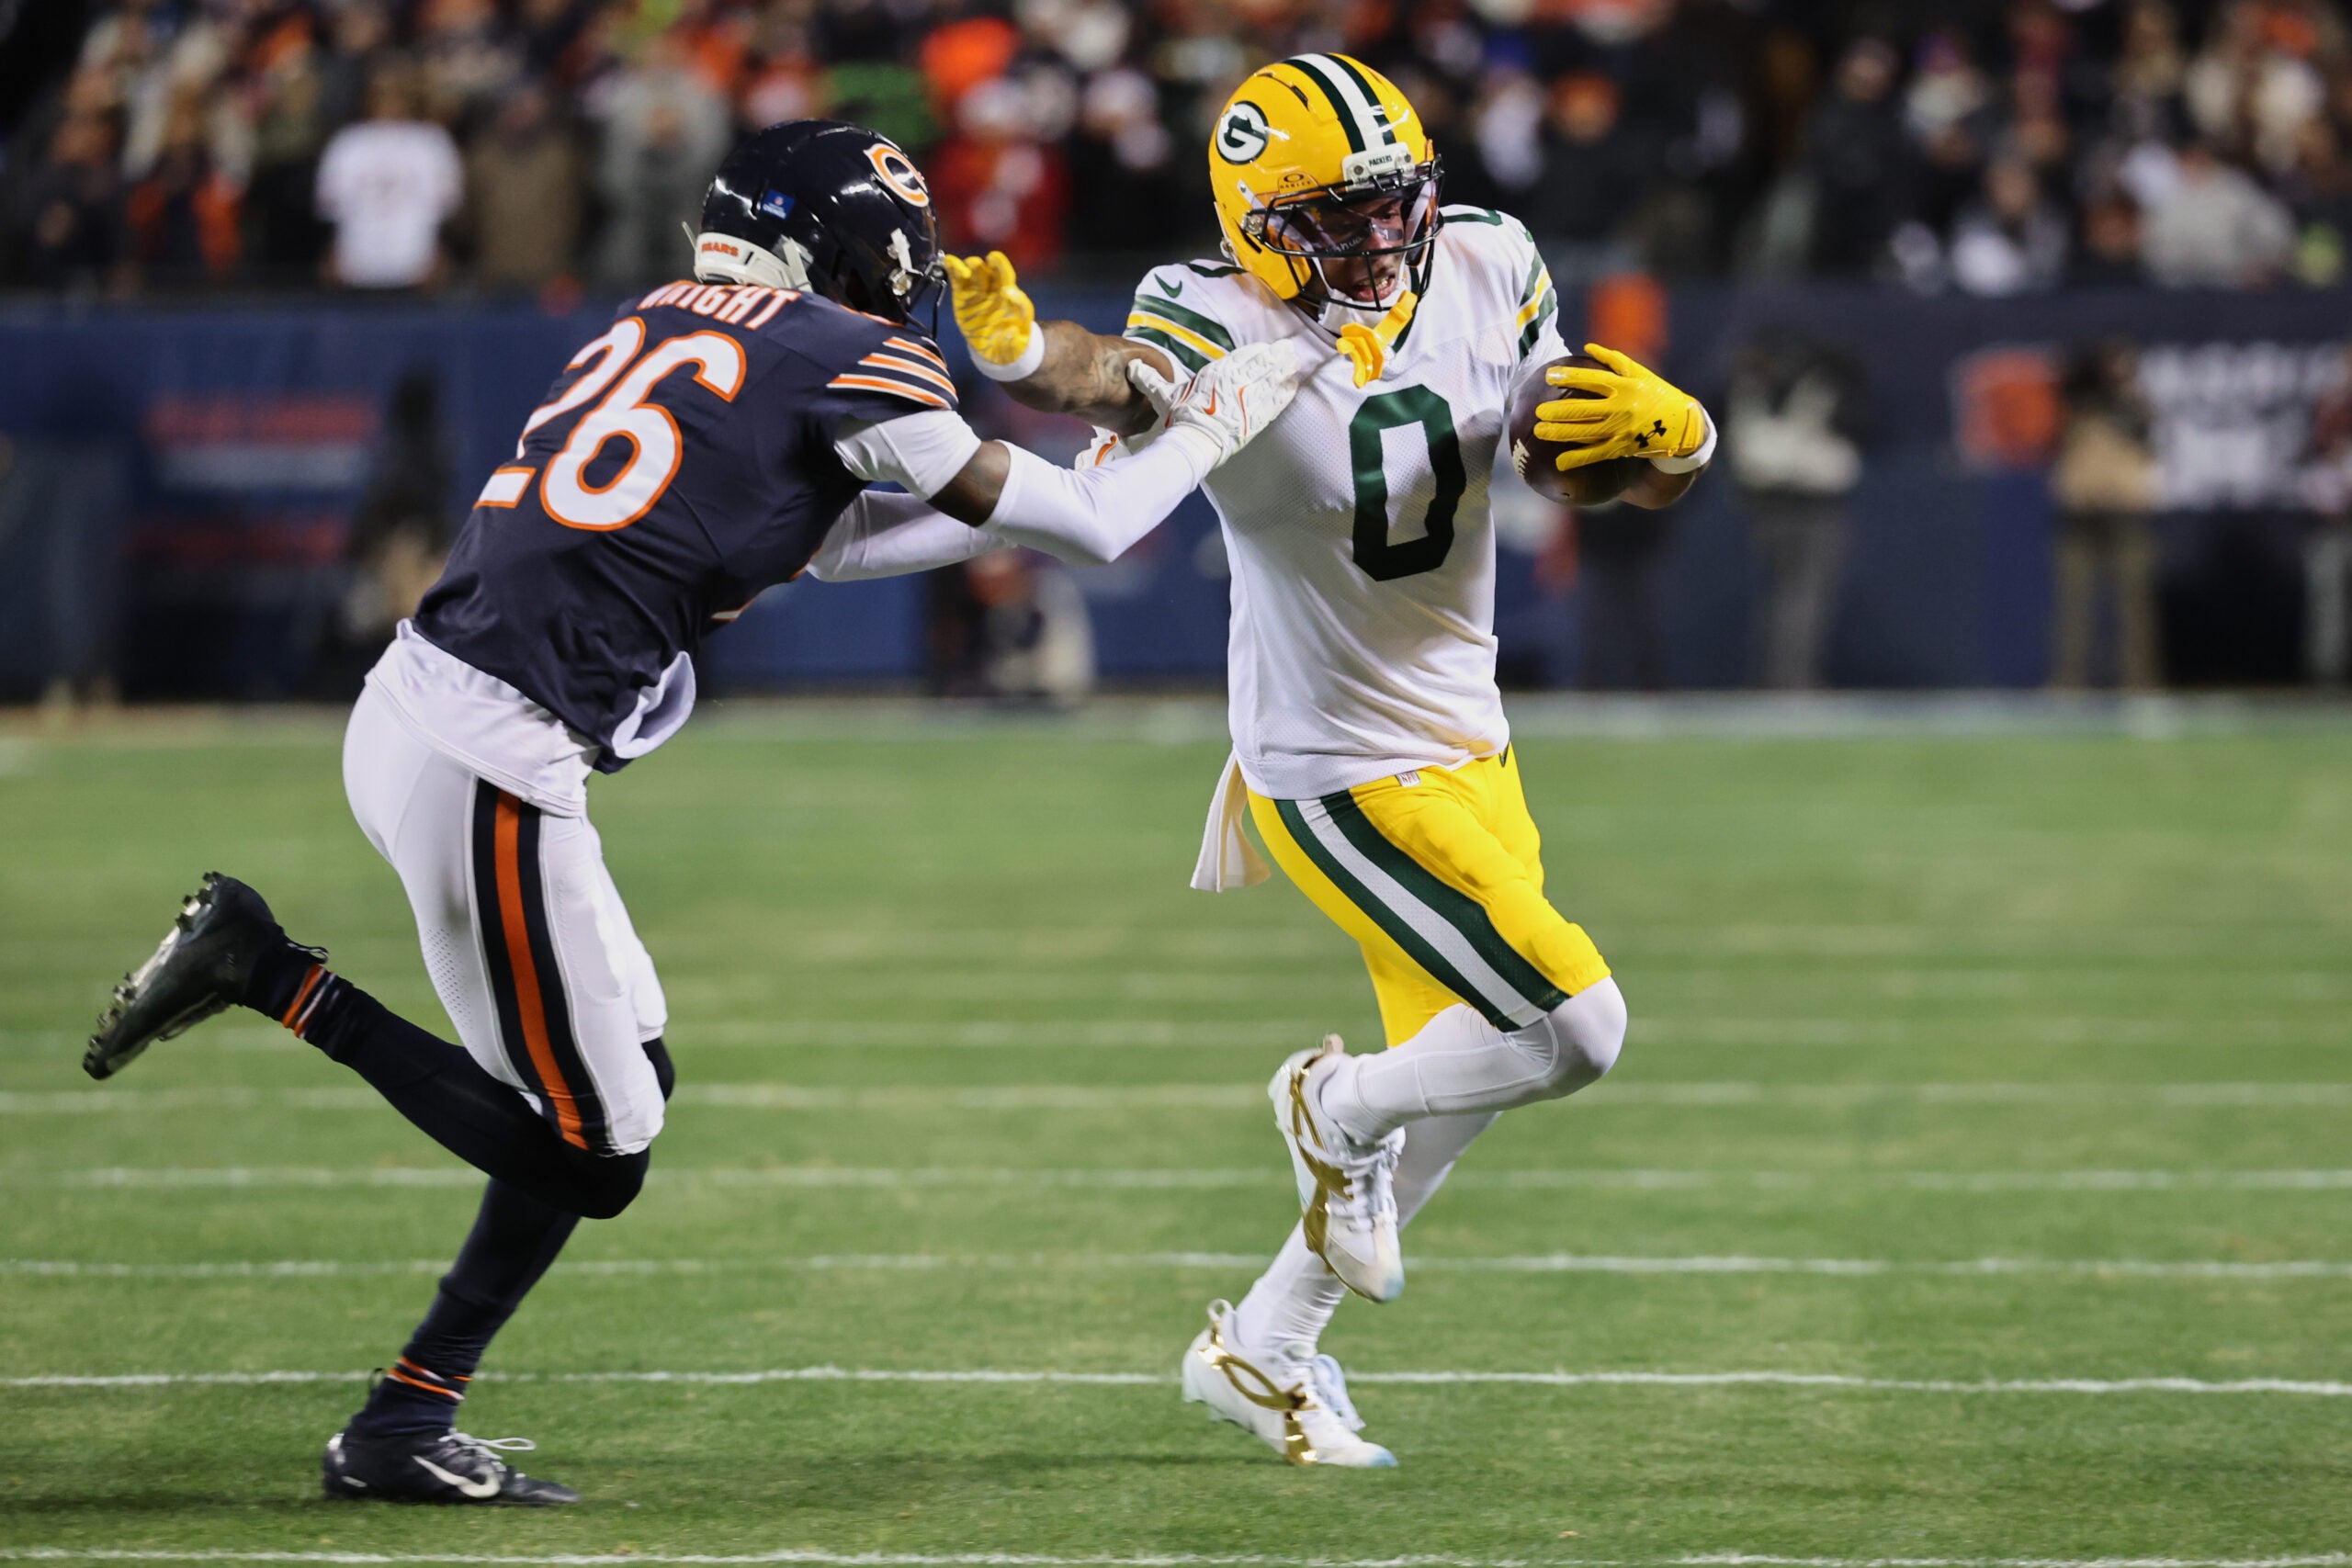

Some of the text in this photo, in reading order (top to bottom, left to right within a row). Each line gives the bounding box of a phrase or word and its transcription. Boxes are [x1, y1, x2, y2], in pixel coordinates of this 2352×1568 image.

[1368, 154, 1393, 166] PACKERS
[473, 316, 746, 531] 26
[1350, 384, 1466, 581] 0
